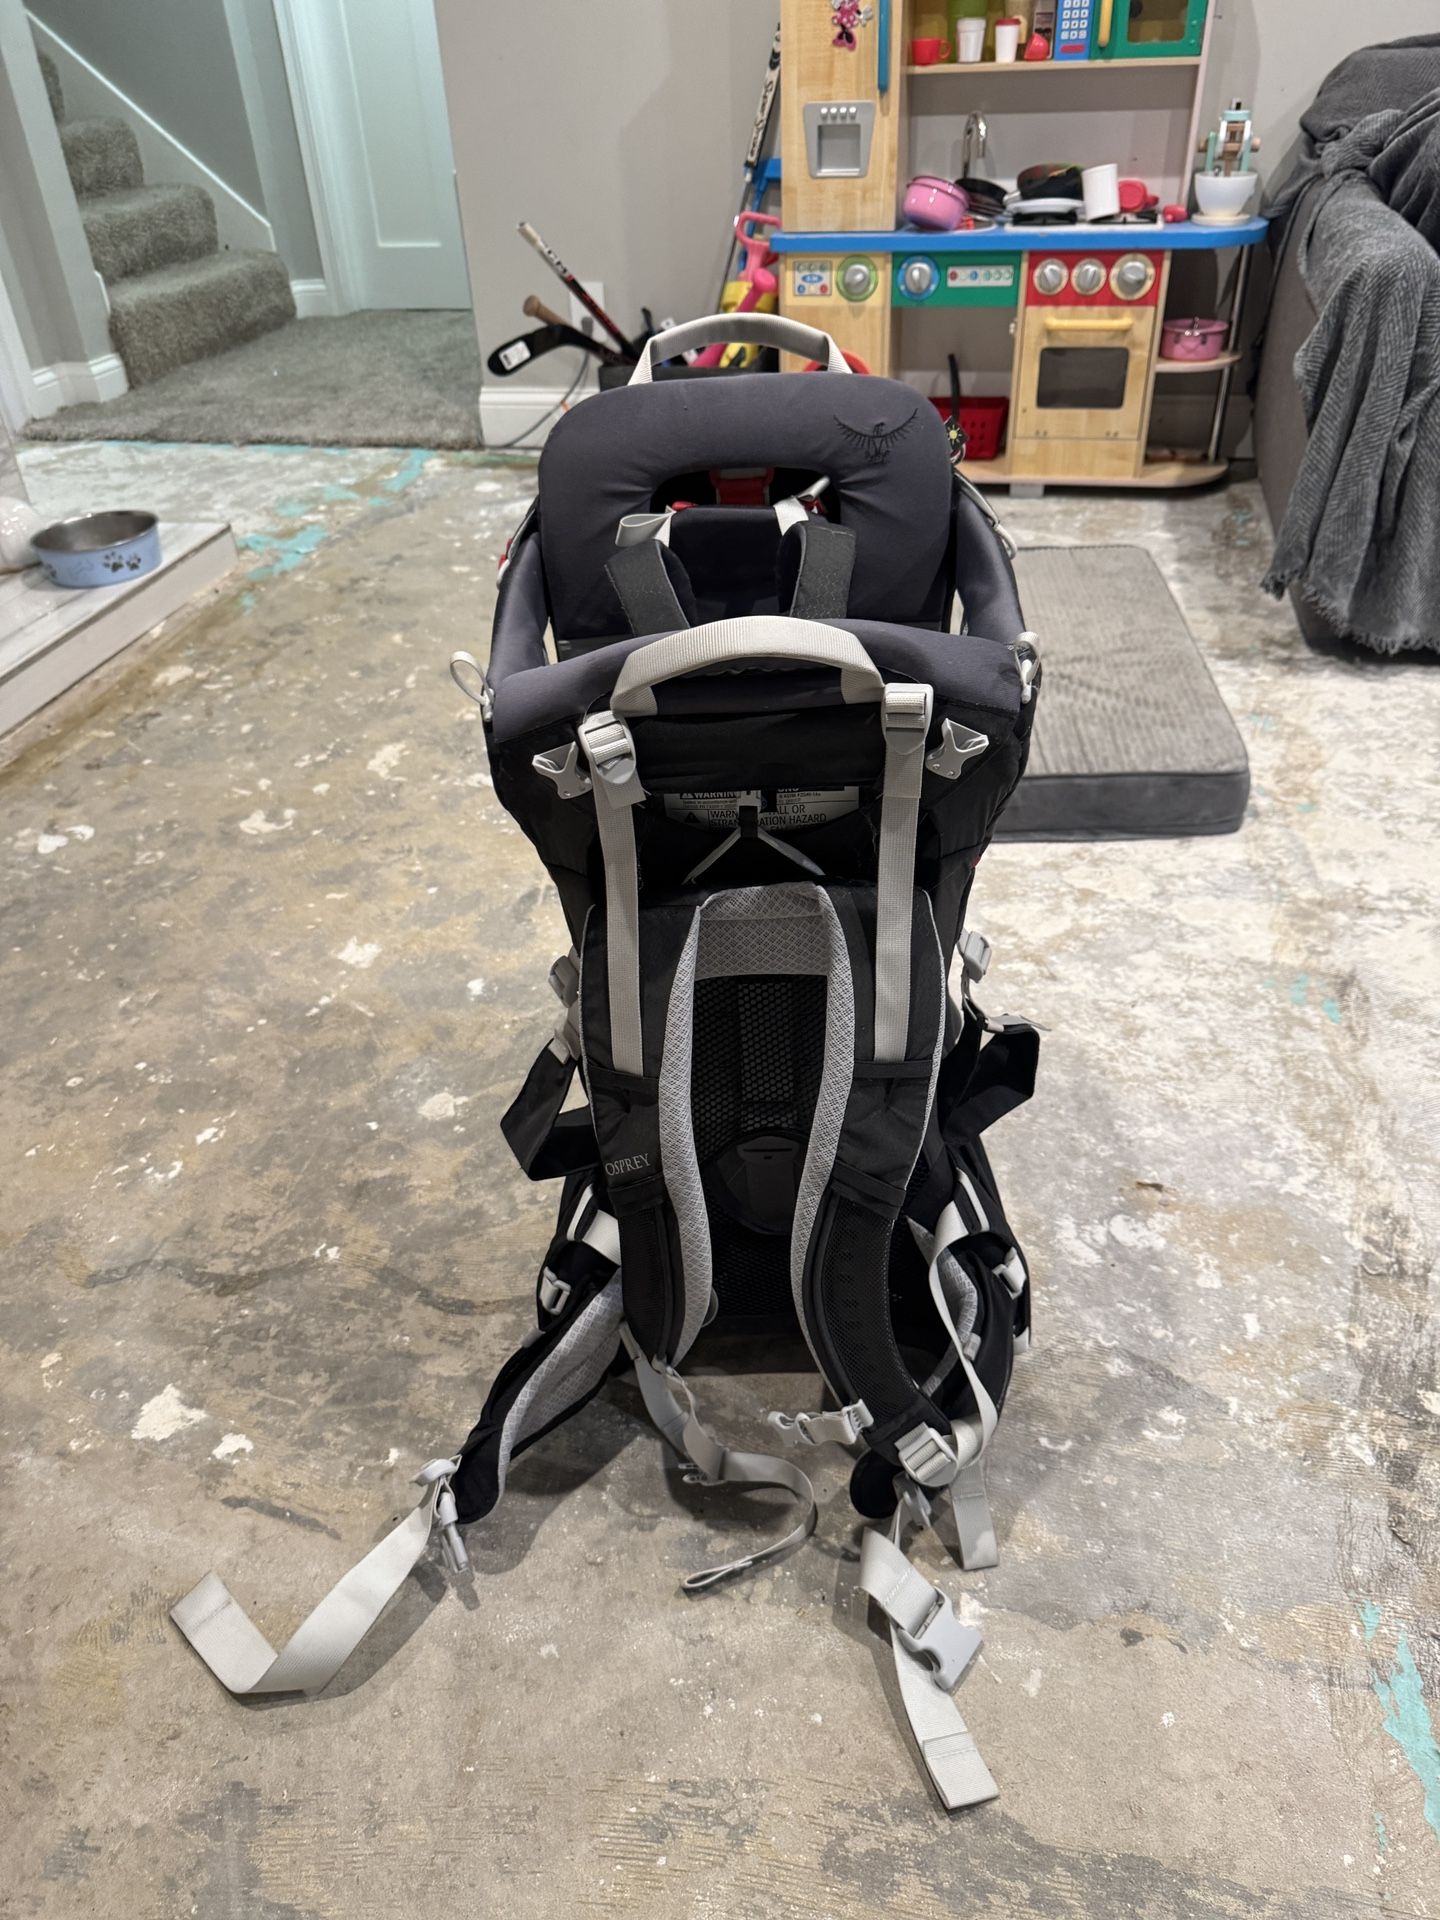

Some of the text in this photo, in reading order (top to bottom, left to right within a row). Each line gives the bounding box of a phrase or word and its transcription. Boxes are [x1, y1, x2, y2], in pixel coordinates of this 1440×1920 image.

[694, 791, 738, 799] WARNIN
[792, 804, 806, 814] OR
[789, 813, 827, 825] HAZARD
[605, 1153, 651, 1176] OSPREY
